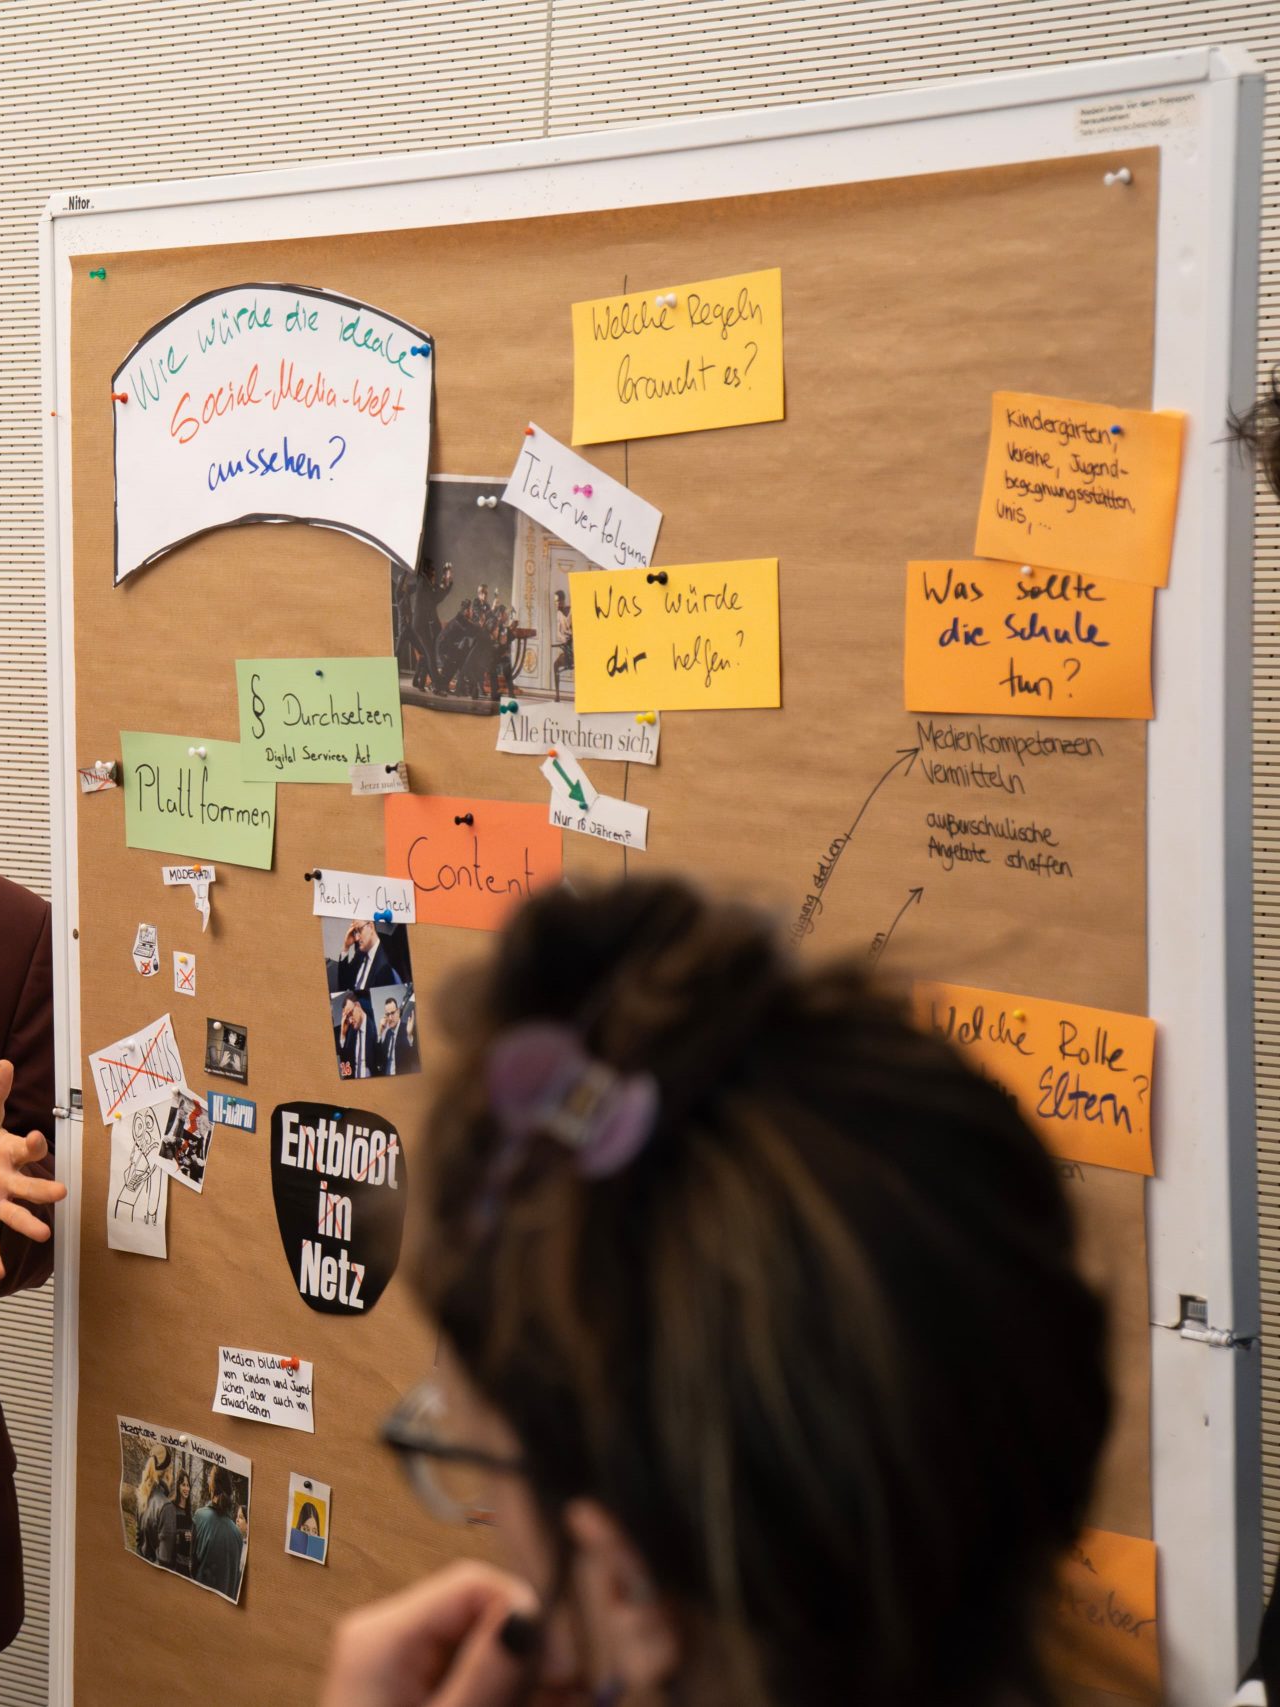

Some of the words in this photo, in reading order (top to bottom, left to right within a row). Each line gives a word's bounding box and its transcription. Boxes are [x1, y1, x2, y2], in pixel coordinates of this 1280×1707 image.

[69, 195, 90, 210] Nitor
[592, 302, 674, 340] Welche
[687, 288, 762, 340] Regeln
[130, 346, 189, 410] Wie
[198, 298, 273, 353] würde
[286, 300, 318, 332] die
[339, 315, 415, 378] ideale
[617, 355, 715, 404] braucht
[723, 341, 758, 390] es?
[208, 436, 346, 491] aussehen?
[1070, 452, 1129, 484] Jugend-
[594, 590, 642, 619] Was
[664, 582, 743, 616] würde
[923, 568, 984, 604] Was
[1016, 574, 1107, 601] sollte
[938, 618, 991, 647] die
[1004, 611, 1111, 647] Schule
[606, 644, 647, 678] dir
[671, 630, 745, 688] helfen?
[282, 692, 393, 728] Durchsetzen
[502, 714, 540, 745] Alle
[542, 717, 614, 751] fürchten
[617, 725, 655, 758] sich,
[916, 720, 1104, 766] Medienkompetenzen
[265, 744, 297, 770] Digital
[302, 746, 348, 763] Services
[354, 745, 371, 764] Act
[554, 811, 572, 826] Nur
[407, 835, 536, 897] Content
[1005, 850, 1074, 877] schaffen
[319, 882, 360, 914] Reality
[375, 886, 411, 913] Check
[1058, 1020, 1129, 1072] Rolle
[280, 1110, 400, 1190] Entblößt
[318, 1180, 353, 1242] im
[299, 1239, 365, 1309] Netz
[273, 1379, 288, 1390] und
[273, 1395, 294, 1409] auch
